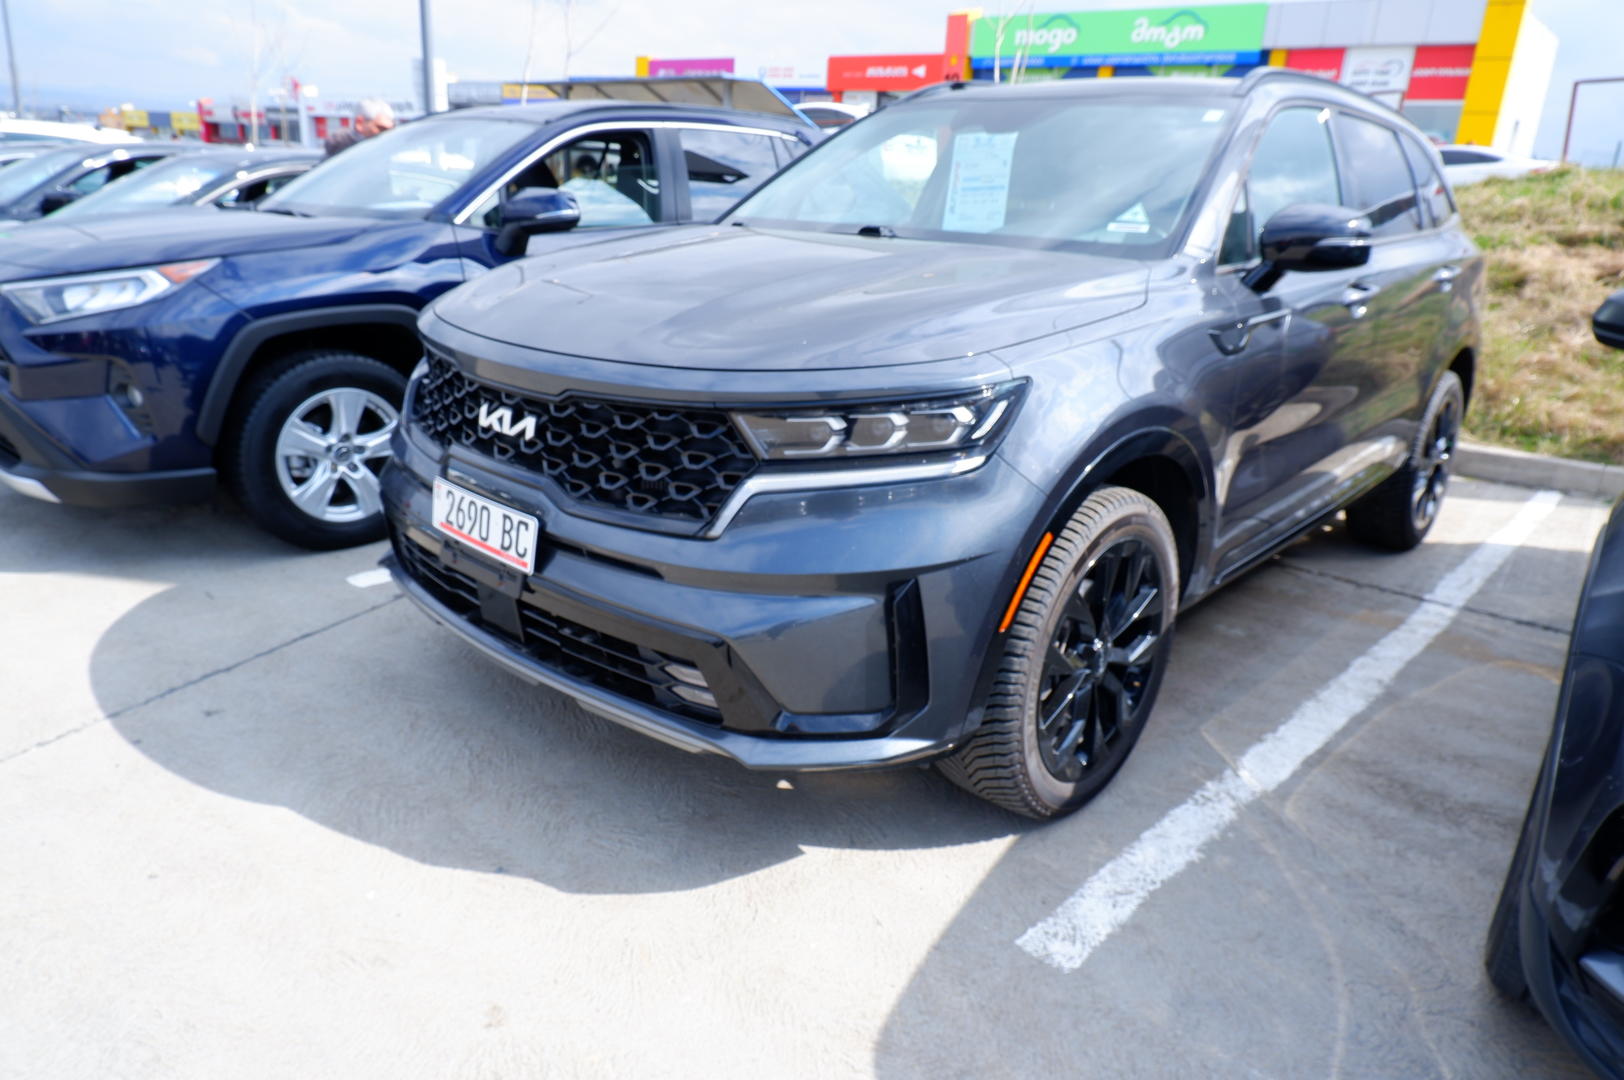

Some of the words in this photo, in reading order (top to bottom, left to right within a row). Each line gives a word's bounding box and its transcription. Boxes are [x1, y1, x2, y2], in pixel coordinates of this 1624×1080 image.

[1014, 27, 1078, 53] mogo
[478, 403, 537, 442] KIA
[445, 489, 491, 542] 2690
[500, 513, 530, 559] BC
